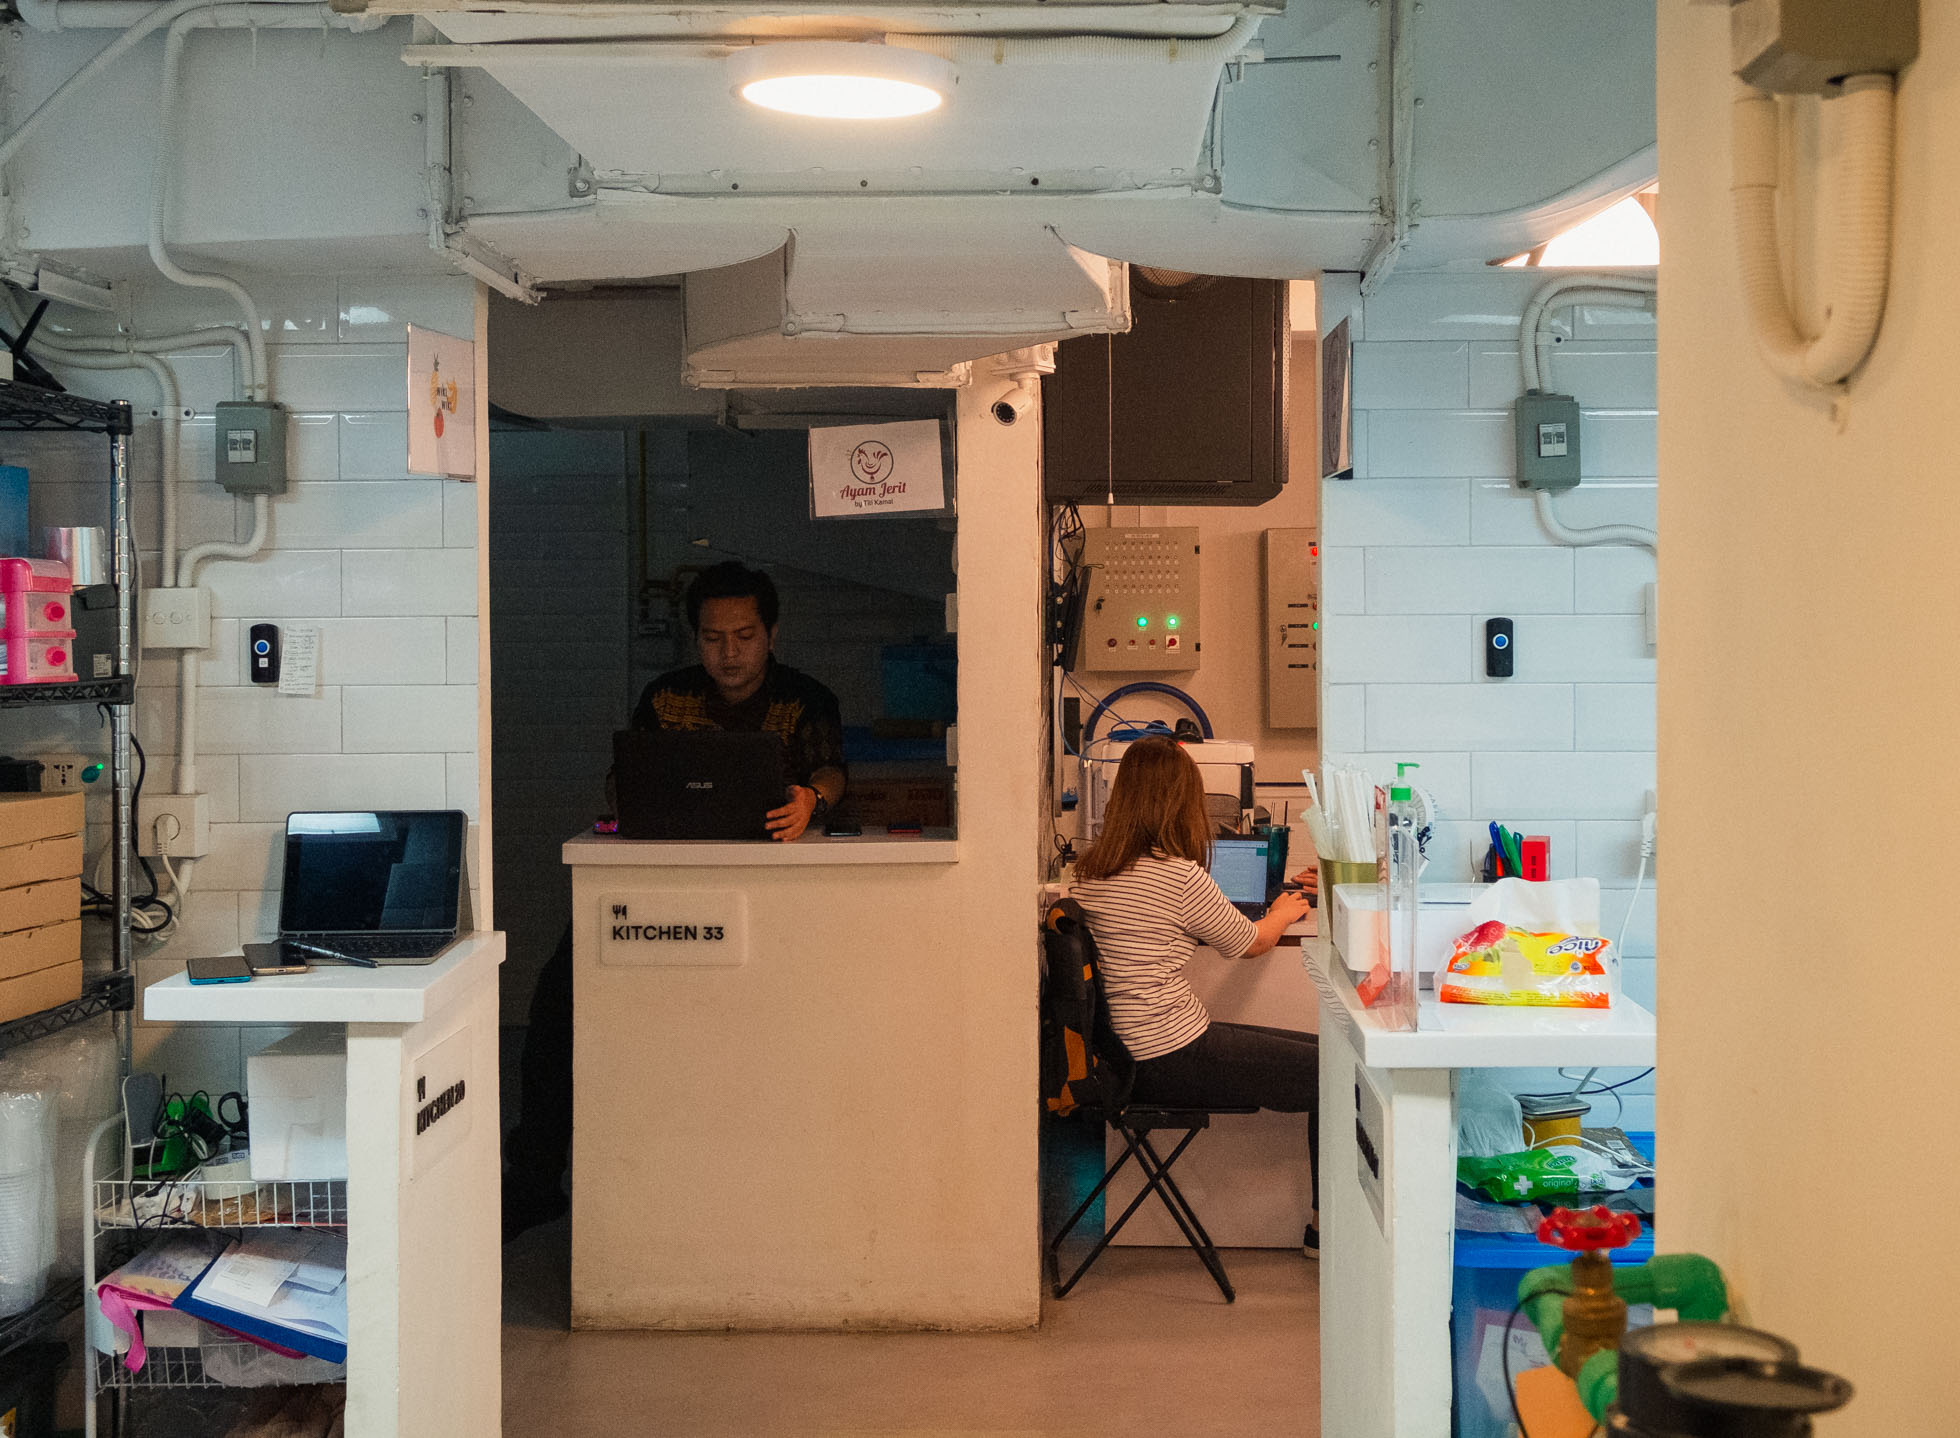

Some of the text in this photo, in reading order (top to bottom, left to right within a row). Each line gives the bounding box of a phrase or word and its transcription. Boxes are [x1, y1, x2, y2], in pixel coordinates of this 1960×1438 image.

[840, 482, 907, 500] Ayam Jerit
[854, 500, 863, 508] by
[874, 498, 894, 506] Kamal
[613, 925, 724, 940] KITCHEN 33
[1547, 938, 1601, 957] nice
[416, 1085, 455, 1135] KITCHEN
[1542, 1177, 1574, 1189] original
